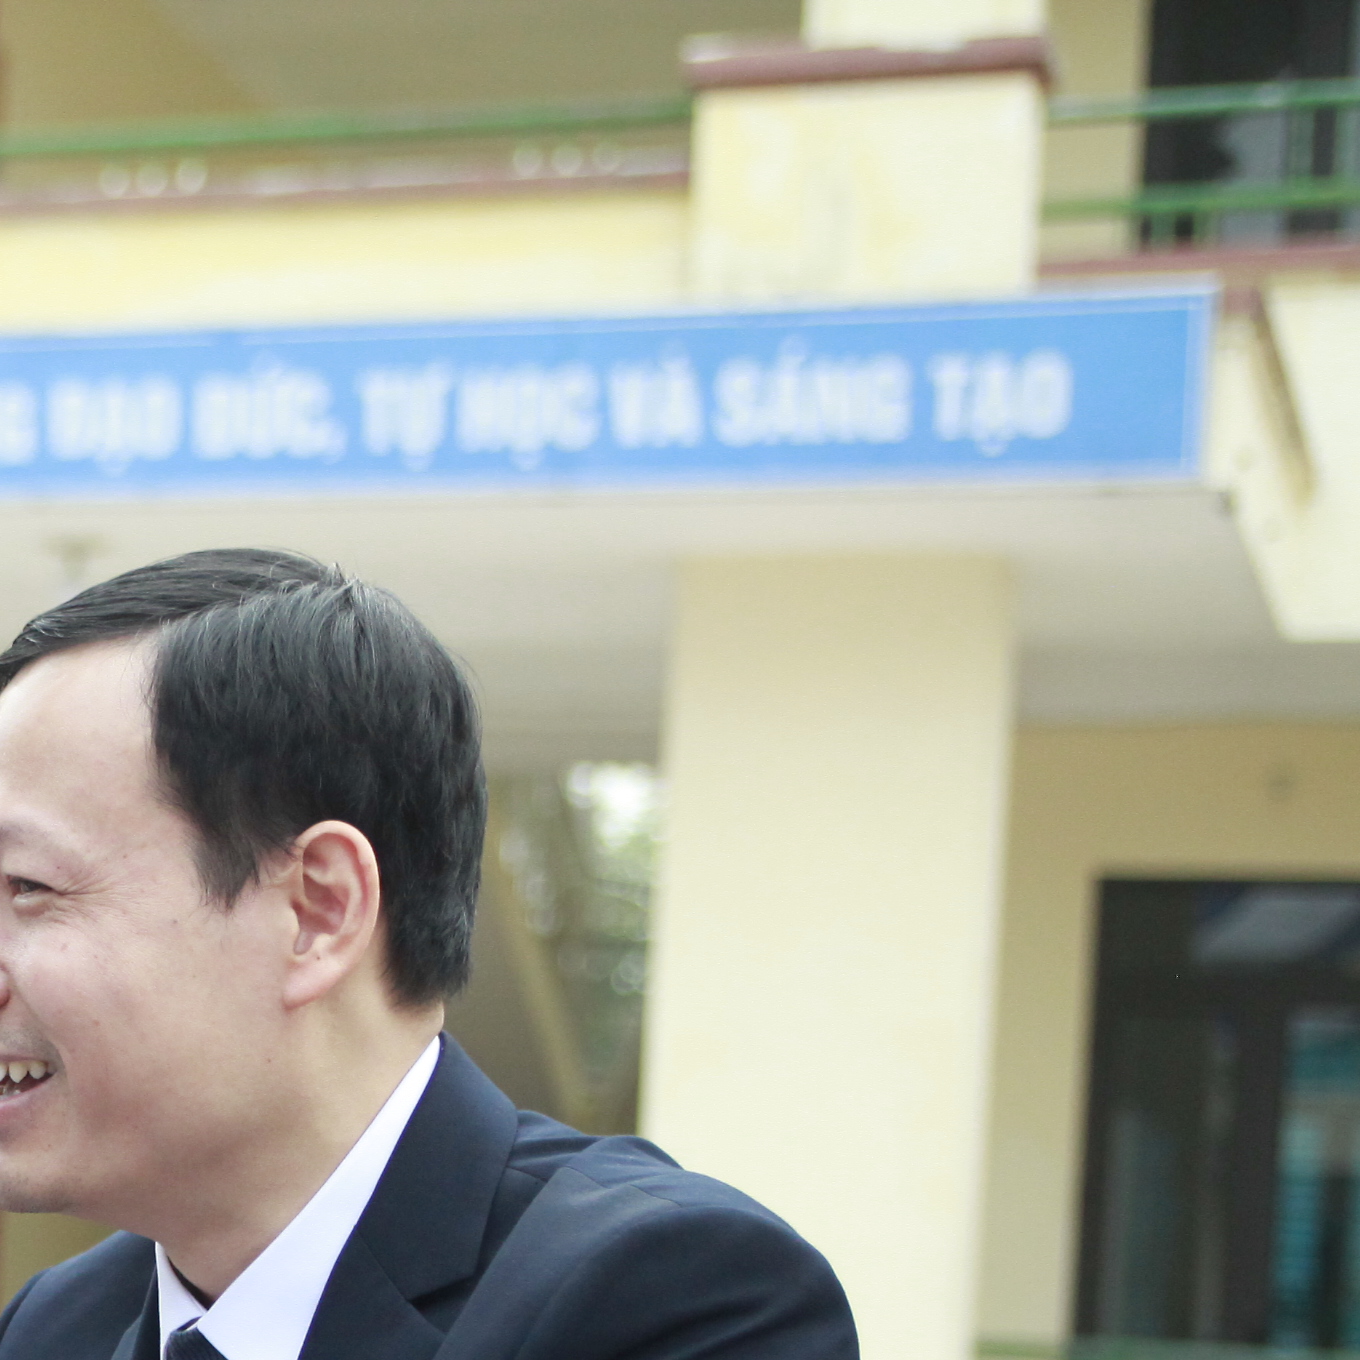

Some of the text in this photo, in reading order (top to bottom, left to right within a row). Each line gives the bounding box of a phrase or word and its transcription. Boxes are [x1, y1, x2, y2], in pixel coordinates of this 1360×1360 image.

[457, 362, 599, 469] HỌC
[608, 342, 702, 448] VÀ
[713, 335, 911, 445] SÁNG
[926, 350, 1072, 456] TẠO
